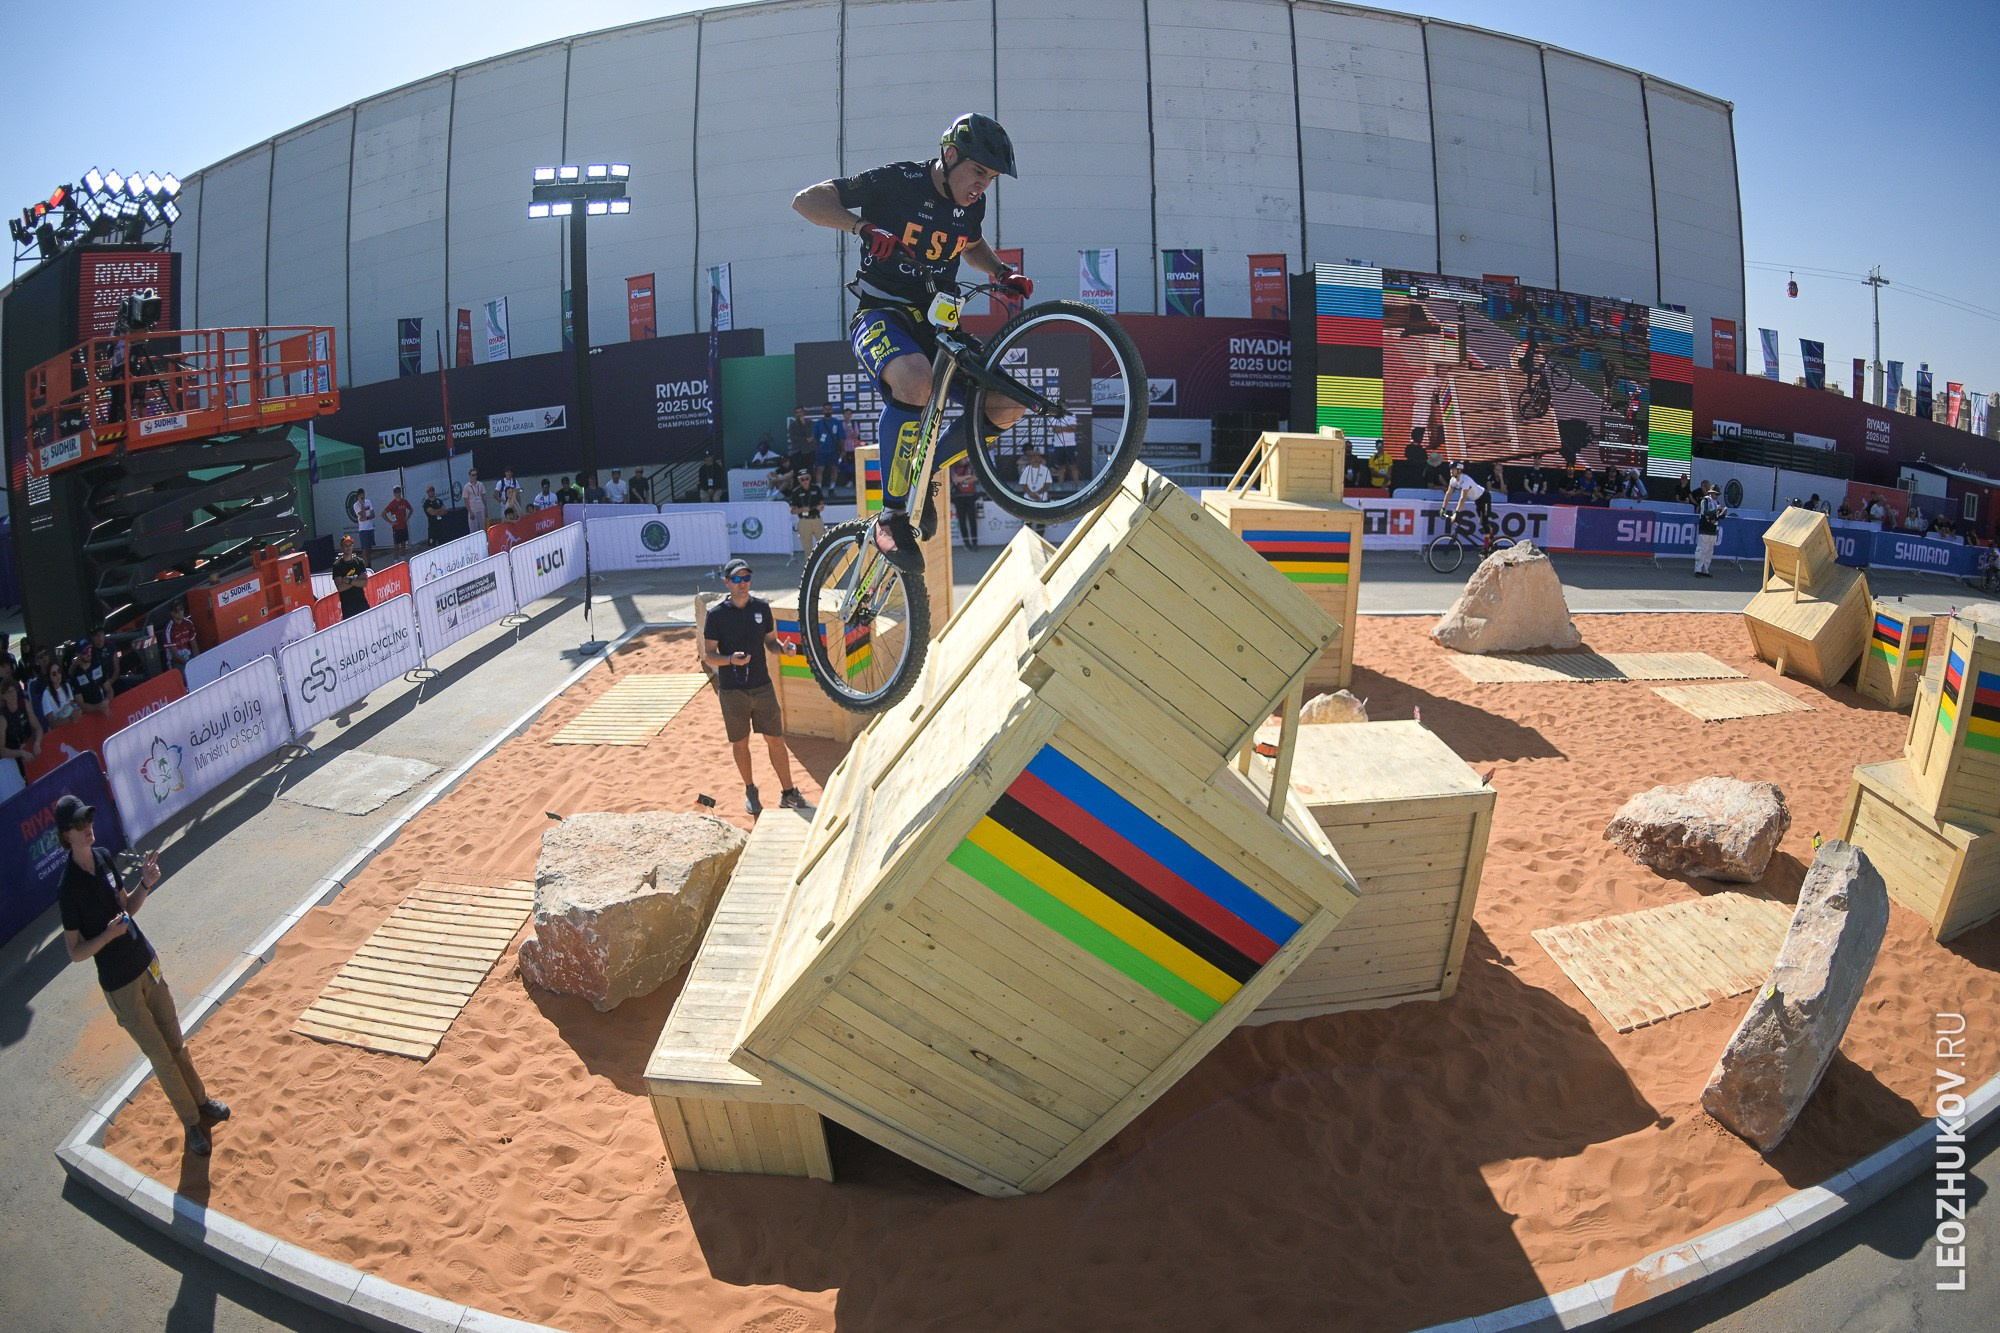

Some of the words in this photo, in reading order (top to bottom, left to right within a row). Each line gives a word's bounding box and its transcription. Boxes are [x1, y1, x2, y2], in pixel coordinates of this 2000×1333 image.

[94, 262, 158, 284] RIYADH
[1167, 272, 1199, 280] RIYADH
[1082, 290, 1114, 298] RIYADH
[948, 310, 956, 320] 6
[1230, 338, 1291, 356] RIYADH
[1230, 358, 1264, 370] 2025
[1267, 360, 1291, 372] UCI
[657, 400, 688, 414] 2025
[692, 398, 710, 412] UC
[154, 416, 178, 428] SUDHIR
[492, 416, 514, 425] RIYADH
[493, 424, 511, 434] SAUDI
[512, 422, 534, 430] ARABIA
[658, 418, 707, 429] CHAMPIONSHI
[1866, 418, 1890, 433] RIYADH
[416, 435, 436, 444] WORLD
[437, 428, 487, 442] CHMPIONSHIPS
[429, 426, 444, 434] URBA
[1717, 424, 1739, 437] UCI
[1866, 431, 1879, 442] 2025
[1880, 434, 1890, 444] UCI
[384, 432, 410, 448] UCI
[50, 438, 77, 459] SUDHIR
[536, 518, 555, 532] RIYADH
[1421, 510, 1548, 538] TISSOT
[1617, 519, 1723, 546] SHIMAO
[542, 548, 564, 574] UCI
[1895, 542, 1949, 565] SHIMANO
[230, 582, 252, 598] SUDHIR
[377, 580, 401, 600] RIYADH
[442, 593, 456, 611] UCI
[338, 648, 370, 671] SAUDI
[369, 628, 409, 654] CYCLING
[234, 699, 262, 726] وزارة
[190, 712, 230, 746] الرياضة
[194, 742, 229, 771] Ministry
[230, 734, 242, 748] of
[241, 720, 266, 743] Sport
[20, 800, 56, 842] RIYA
